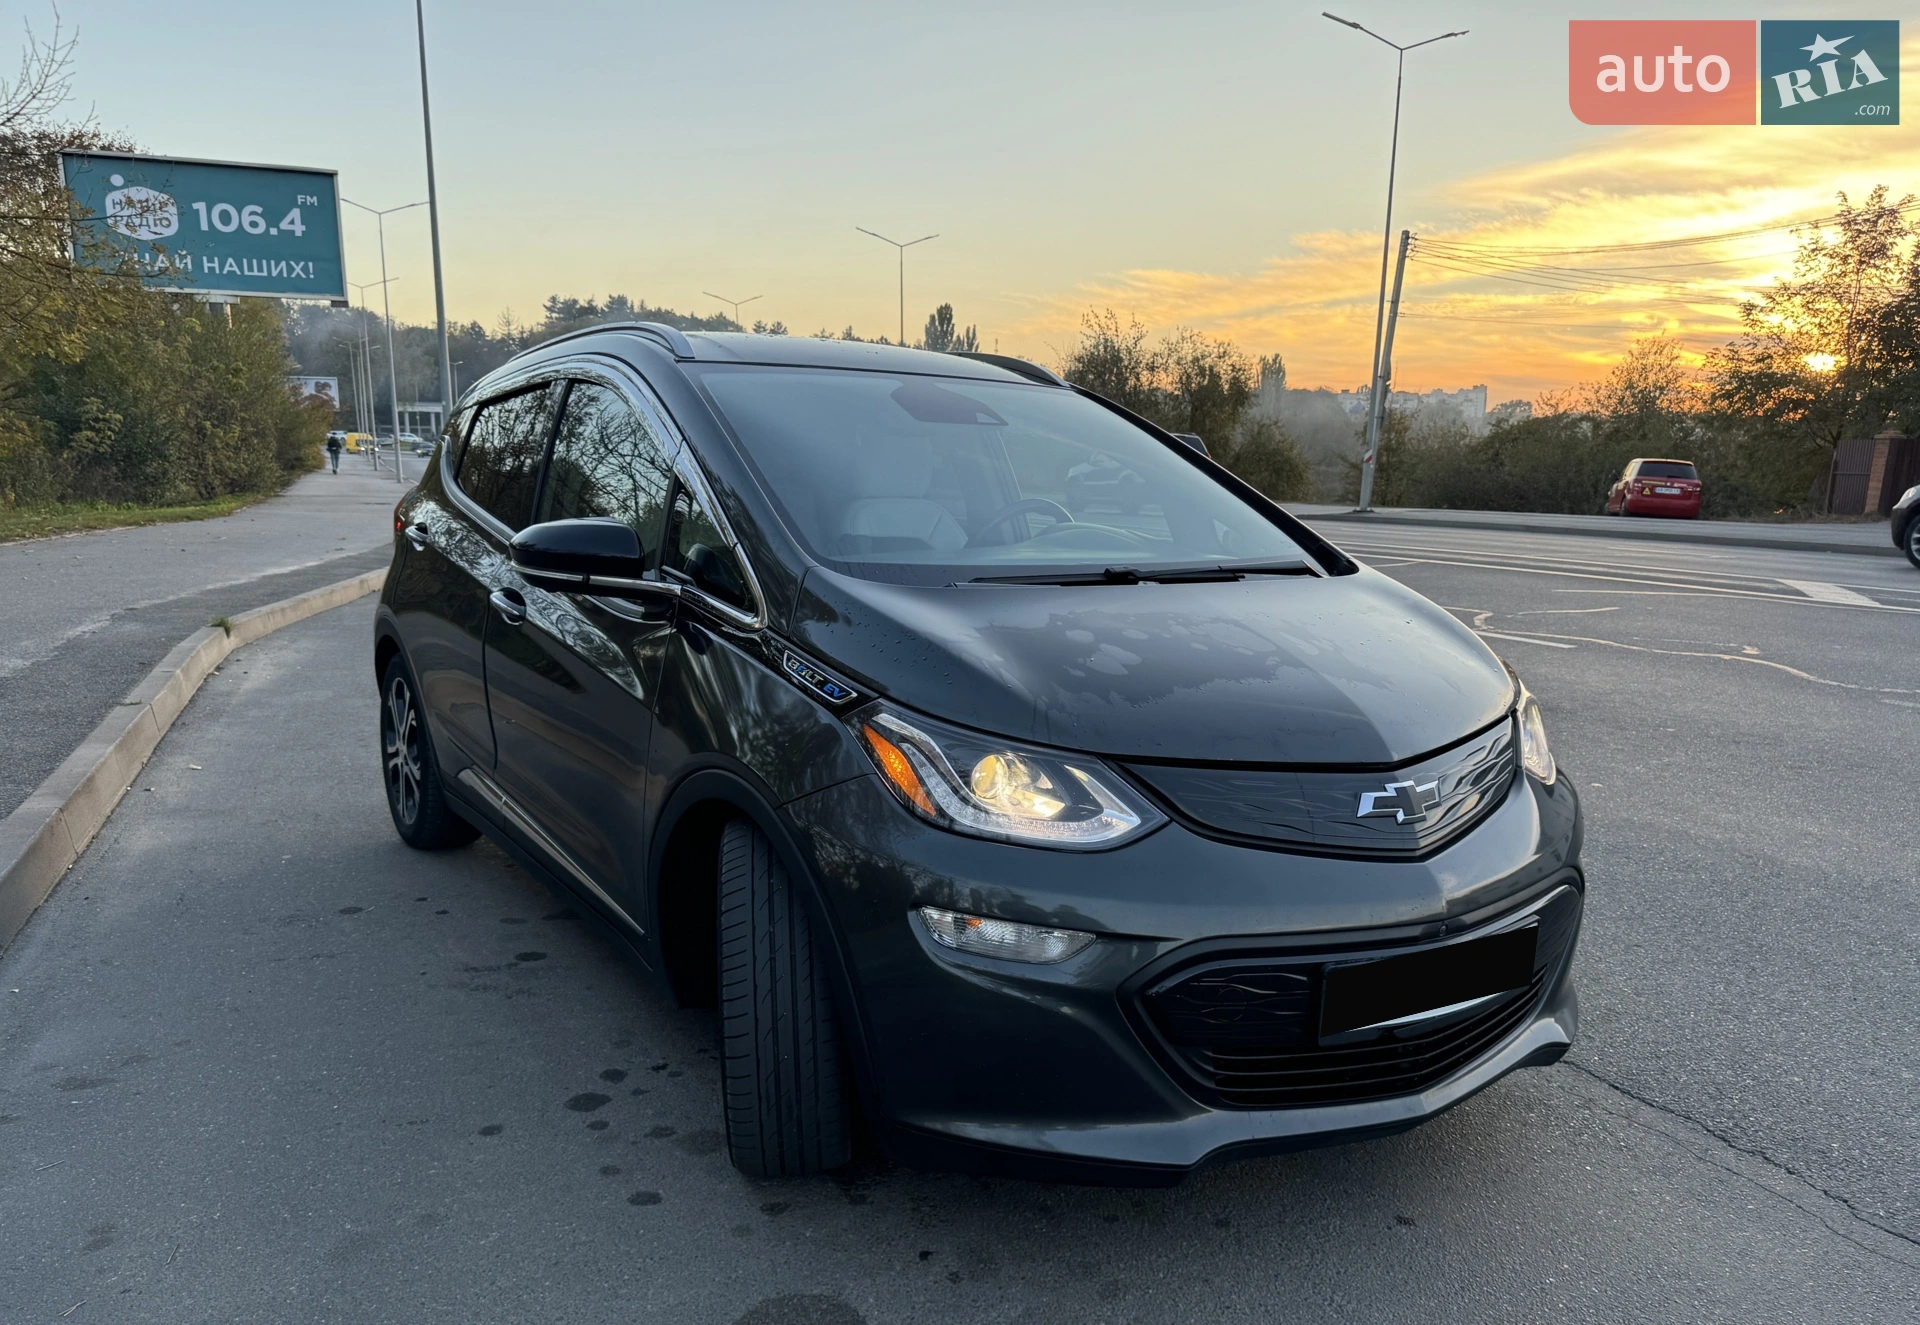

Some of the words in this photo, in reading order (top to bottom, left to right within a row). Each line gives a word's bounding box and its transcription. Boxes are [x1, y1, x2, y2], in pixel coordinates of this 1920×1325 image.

[191, 201, 306, 237] 106.4
[297, 194, 318, 206] FM
[202, 255, 315, 279] НАШИХ!
[823, 683, 847, 698] EV
